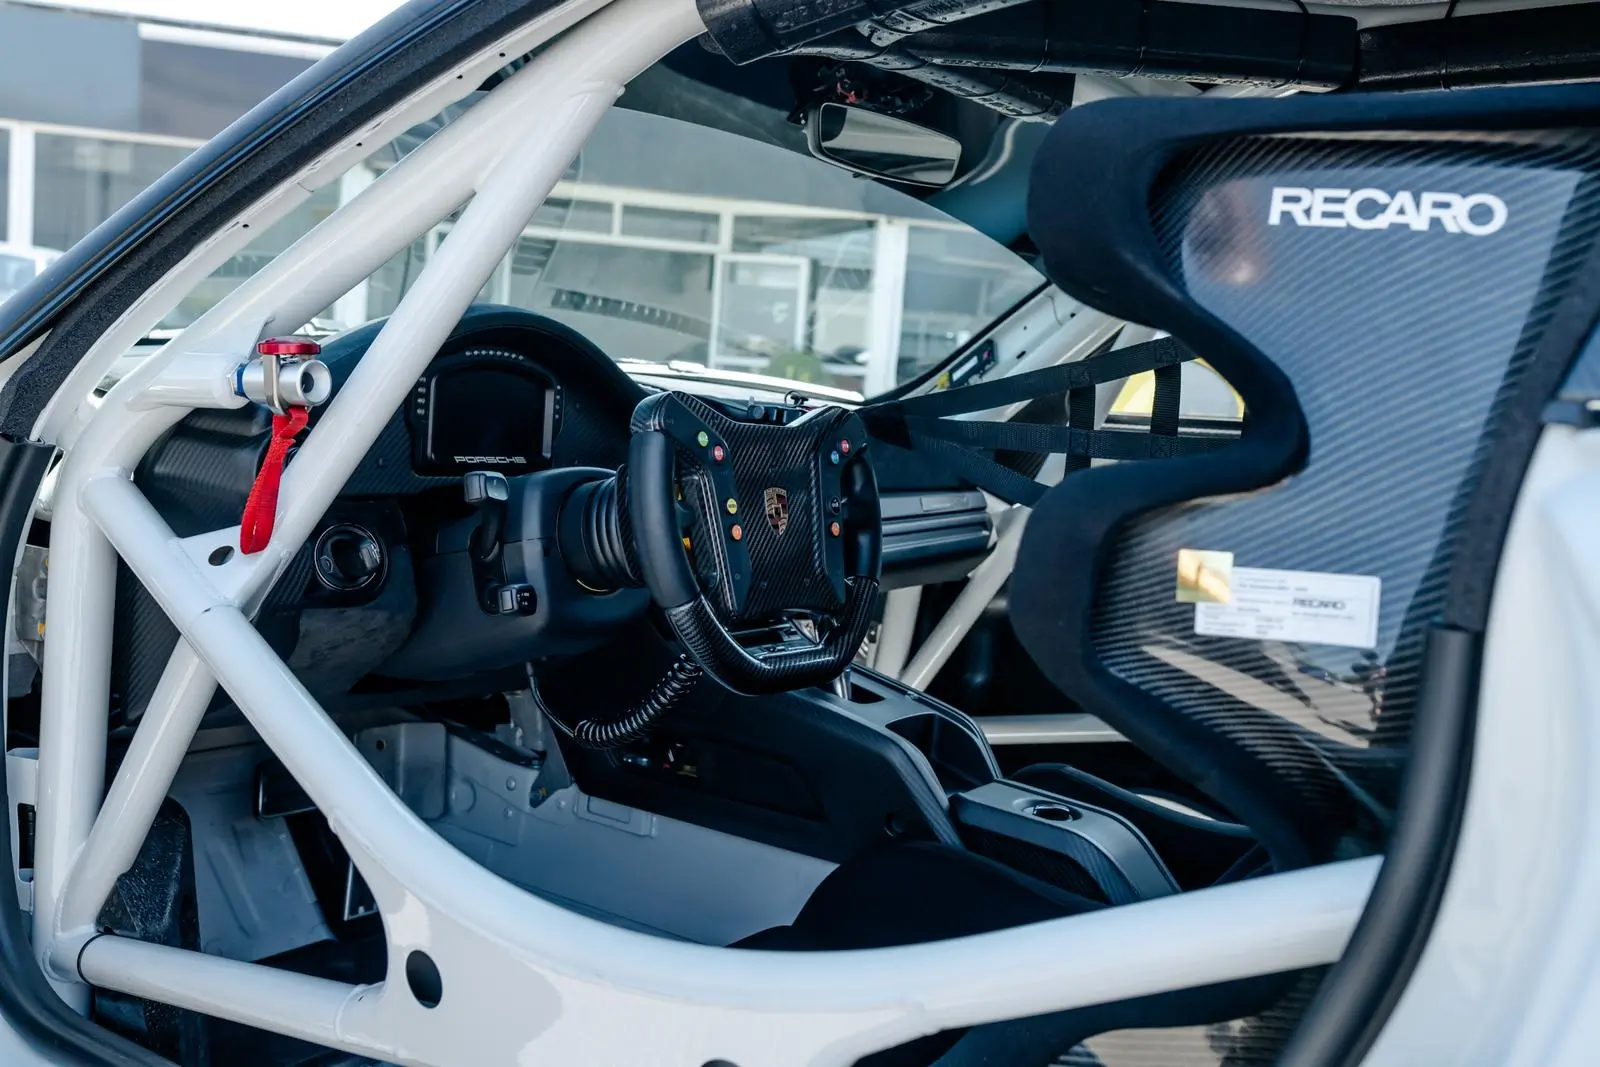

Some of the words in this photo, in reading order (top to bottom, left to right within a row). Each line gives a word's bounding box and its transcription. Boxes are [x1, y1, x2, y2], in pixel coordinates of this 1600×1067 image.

[1268, 187, 1508, 236] RECARO
[454, 456, 527, 464] PORSCHE
[1293, 598, 1346, 610] RECARO
